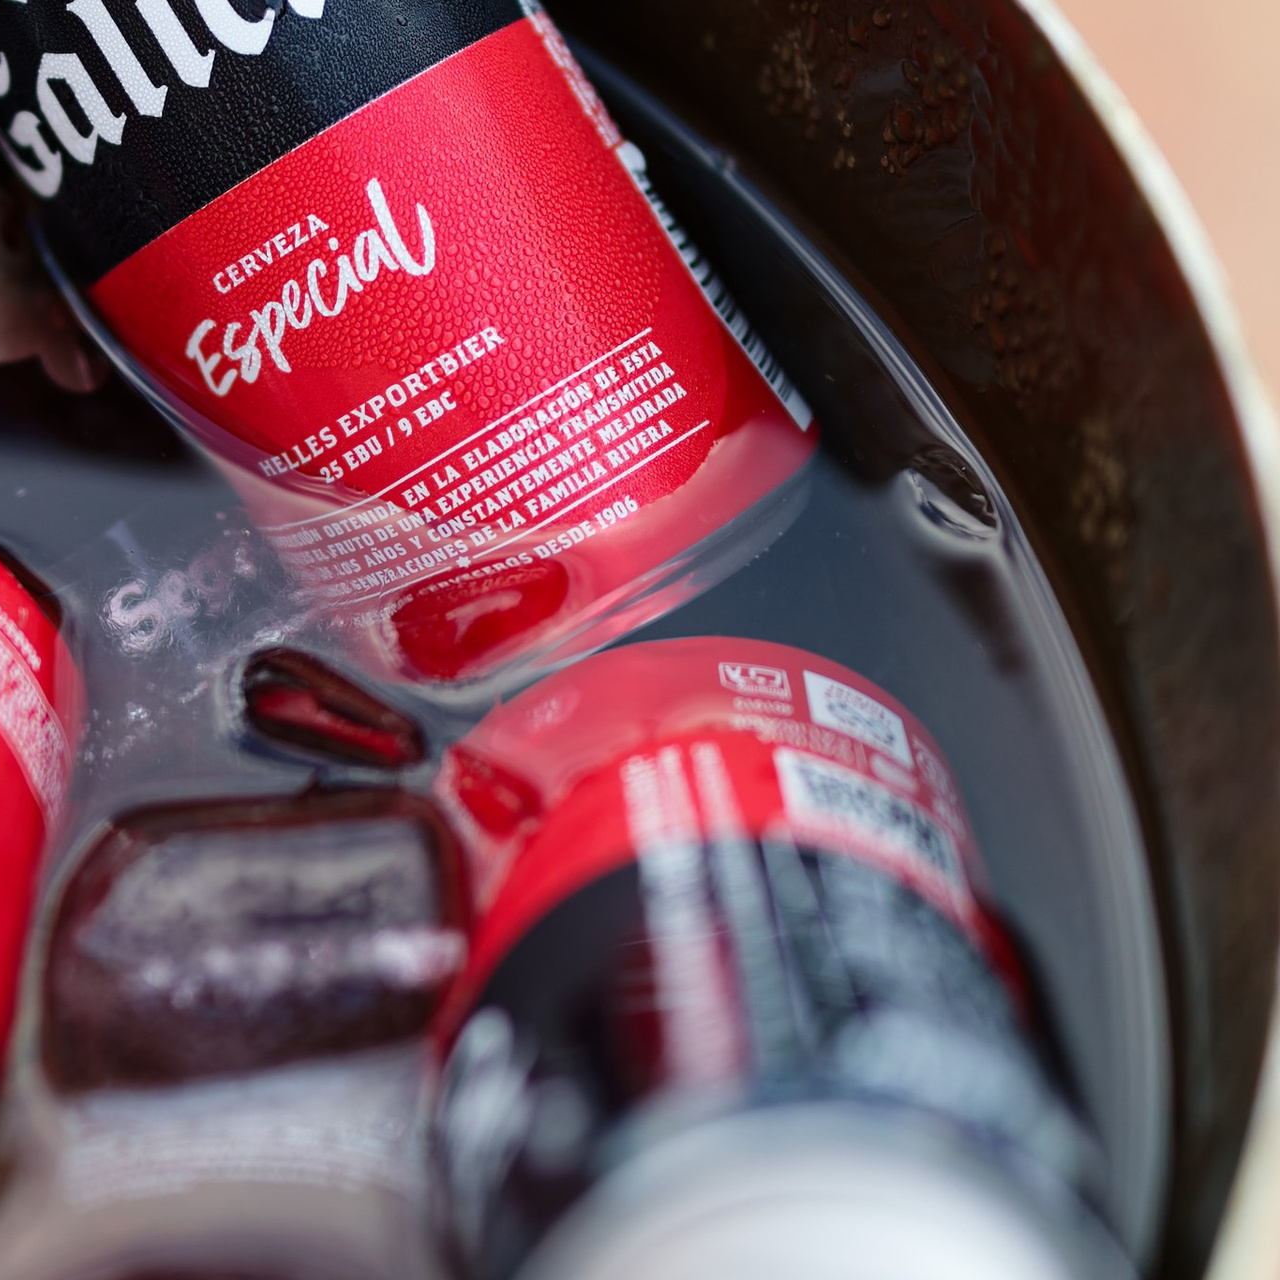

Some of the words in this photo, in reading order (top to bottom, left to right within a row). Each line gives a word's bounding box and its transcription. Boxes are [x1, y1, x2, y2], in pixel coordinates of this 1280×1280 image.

[186, 178, 435, 397] Especial
[212, 214, 329, 294] CERVEZA
[258, 427, 338, 478] HELLES
[337, 326, 506, 438] EXPORTBIER
[320, 460, 344, 484] 25
[342, 435, 384, 472] EBU
[397, 417, 413, 437] 9
[412, 391, 457, 427] EBC
[323, 500, 403, 538] OBTENIDA
[402, 481, 430, 507] EN
[431, 464, 462, 490] LA
[462, 383, 595, 471] ELABORACIÓN
[594, 366, 620, 391] DE
[621, 341, 663, 374] ESTA
[327, 532, 375, 559] FRUTO
[374, 523, 399, 542] DE
[397, 506, 438, 533] UNA
[436, 433, 561, 516] EXPERIENCIA
[559, 362, 675, 440] TRANSMITIDA
[364, 543, 407, 567] AÑOS
[408, 535, 423, 550] Y
[427, 439, 597, 543] CONSTANTEMENTE
[596, 382, 688, 445] MEJORADA
[469, 526, 497, 547] DE
[499, 508, 527, 534] LA
[524, 460, 608, 518] FAMILIA
[605, 420, 674, 470] RIVERA
[535, 520, 596, 560] DESDE
[594, 494, 639, 530] 1906
